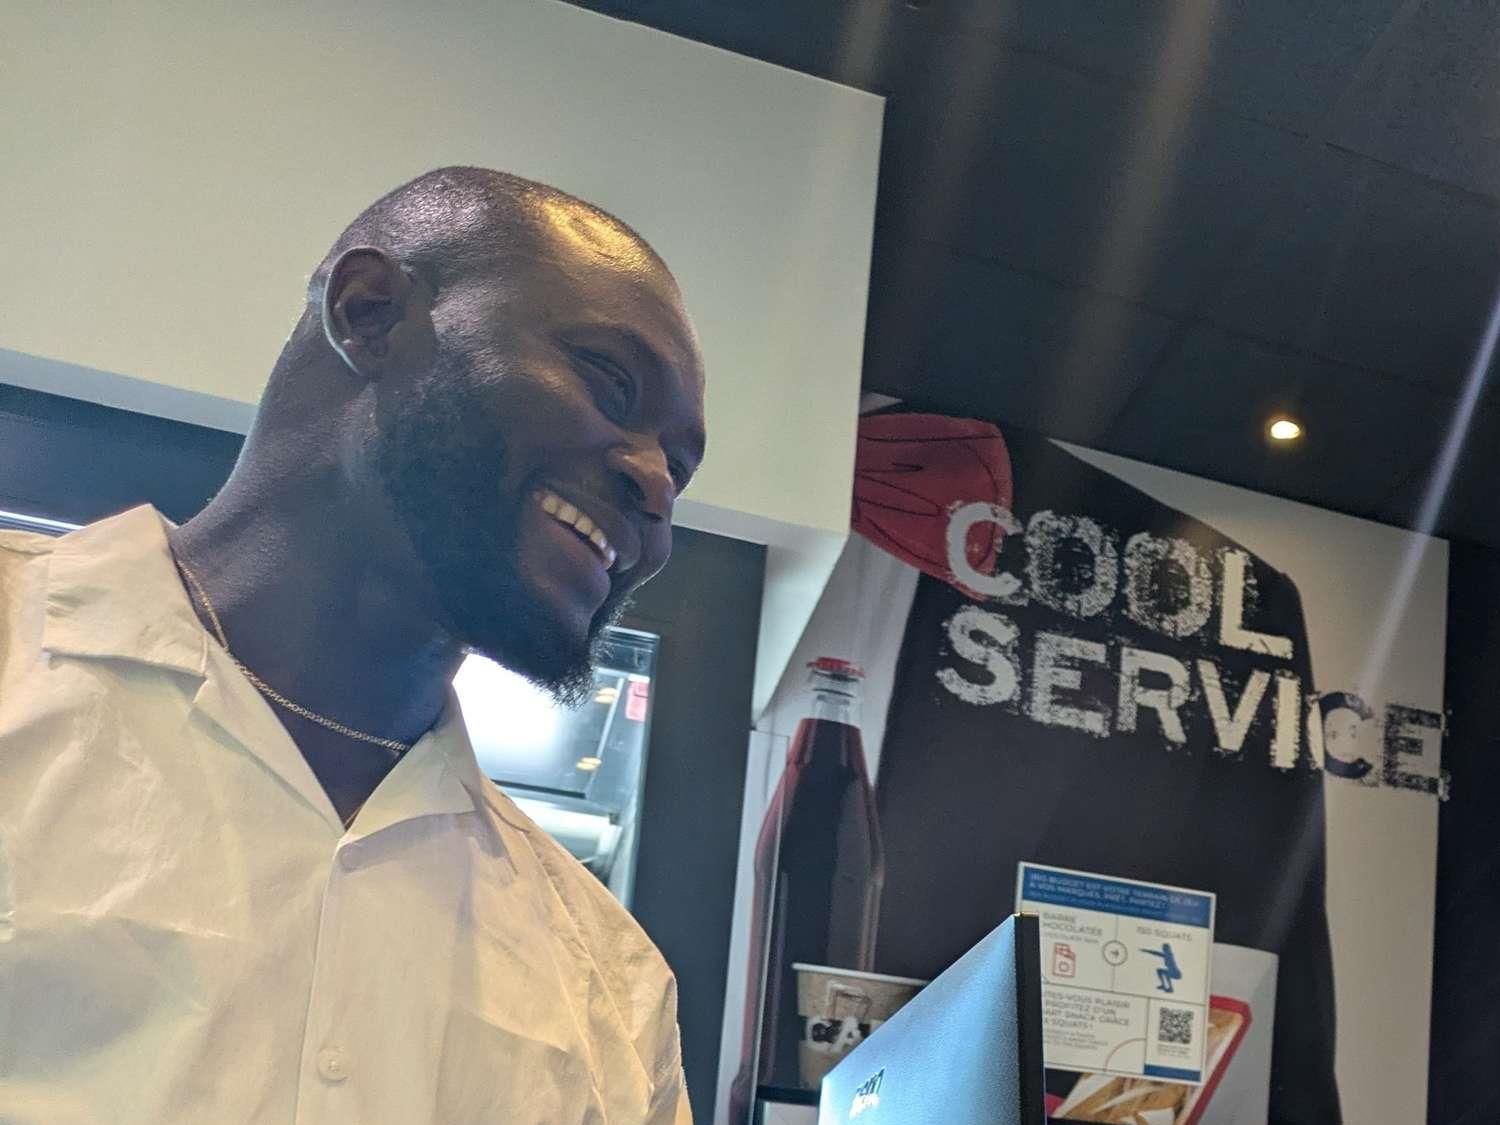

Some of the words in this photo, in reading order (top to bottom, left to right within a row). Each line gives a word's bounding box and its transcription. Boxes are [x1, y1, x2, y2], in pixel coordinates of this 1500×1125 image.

[947, 500, 1294, 659] COOL
[937, 606, 1449, 800] SERVICE
[1154, 928, 1192, 942] SQUATS
